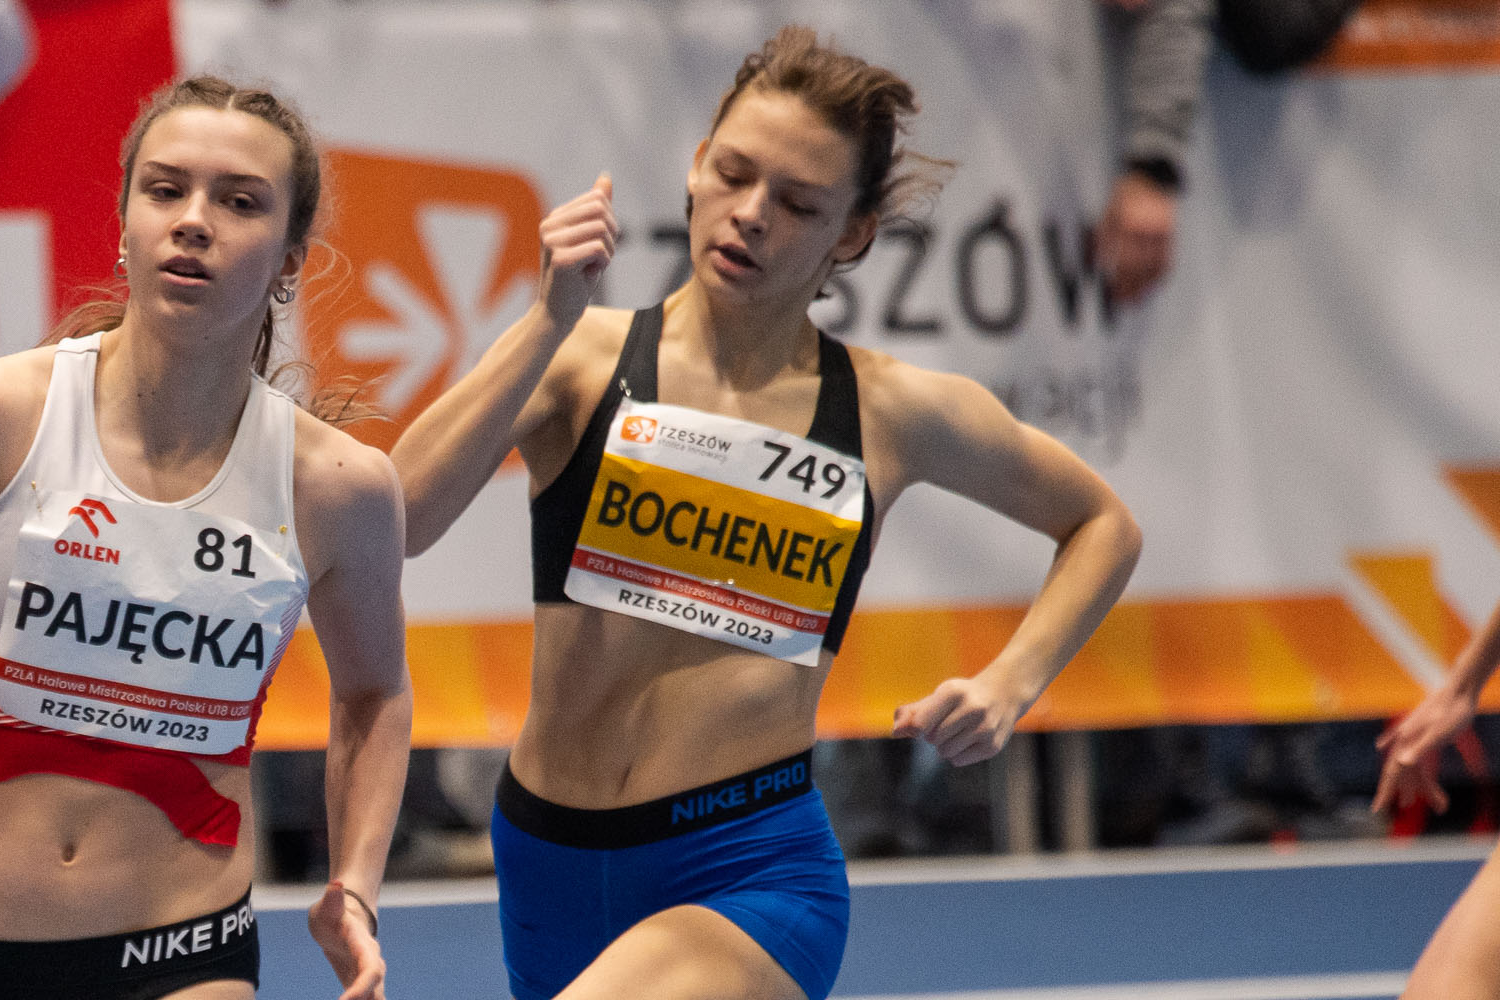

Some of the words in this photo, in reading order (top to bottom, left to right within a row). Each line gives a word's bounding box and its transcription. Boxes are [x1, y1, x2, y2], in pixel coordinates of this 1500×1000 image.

[659, 426, 732, 453] rzeszów
[758, 440, 847, 500] 749
[54, 538, 120, 566] ORLEN
[194, 527, 257, 579] 81
[596, 480, 844, 588] BOCHENEK
[15, 582, 264, 671] PAJĘCKA
[618, 588, 720, 628] RZESZÓW
[723, 618, 774, 645] 2023
[663, 577, 735, 607] Mistrzostwa
[736, 599, 772, 617] Polski
[773, 610, 794, 625] U18
[796, 617, 818, 630] U20
[4, 665, 35, 683] PZLA
[37, 673, 87, 692] Halowe
[88, 683, 166, 708] Mistrzostwa
[169, 699, 206, 714] Polski
[208, 703, 229, 717] U18
[40, 698, 153, 735] RZESZÓW
[156, 720, 209, 742] 2023
[671, 784, 747, 824] NIKE
[754, 761, 805, 798] PRO
[121, 919, 213, 968] NIKE
